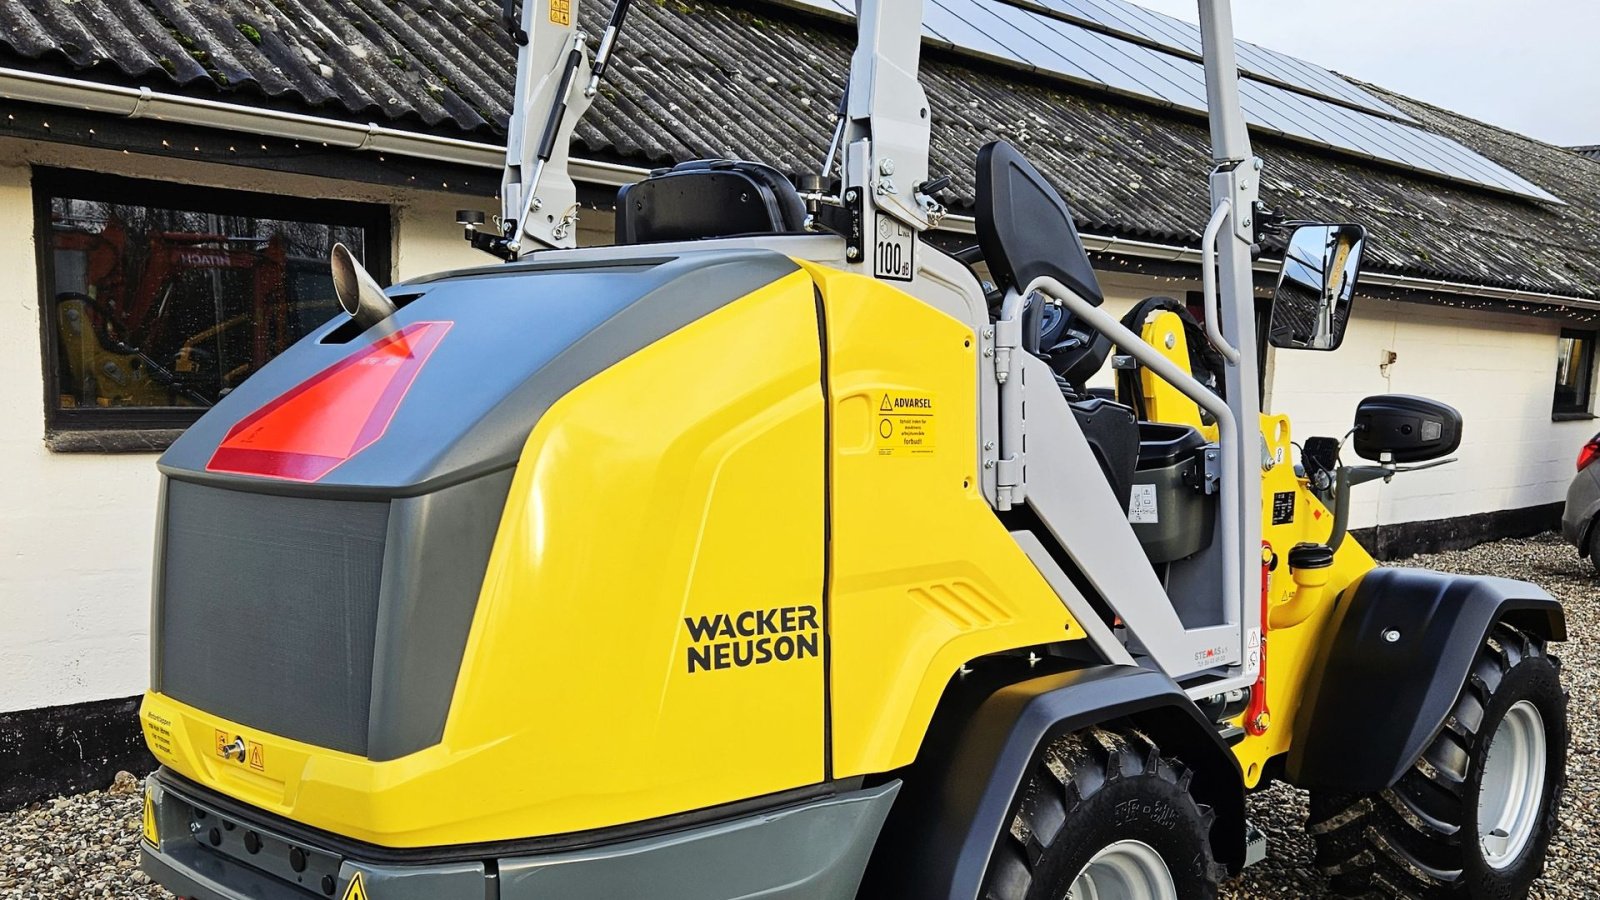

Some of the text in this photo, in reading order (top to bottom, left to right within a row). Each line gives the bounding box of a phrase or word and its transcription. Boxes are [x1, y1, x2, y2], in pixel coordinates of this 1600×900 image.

[878, 241, 909, 276] 100 dB
[894, 398, 931, 408] ADVARSEL
[684, 605, 819, 643] WACKER
[687, 632, 819, 674] NEUSON
